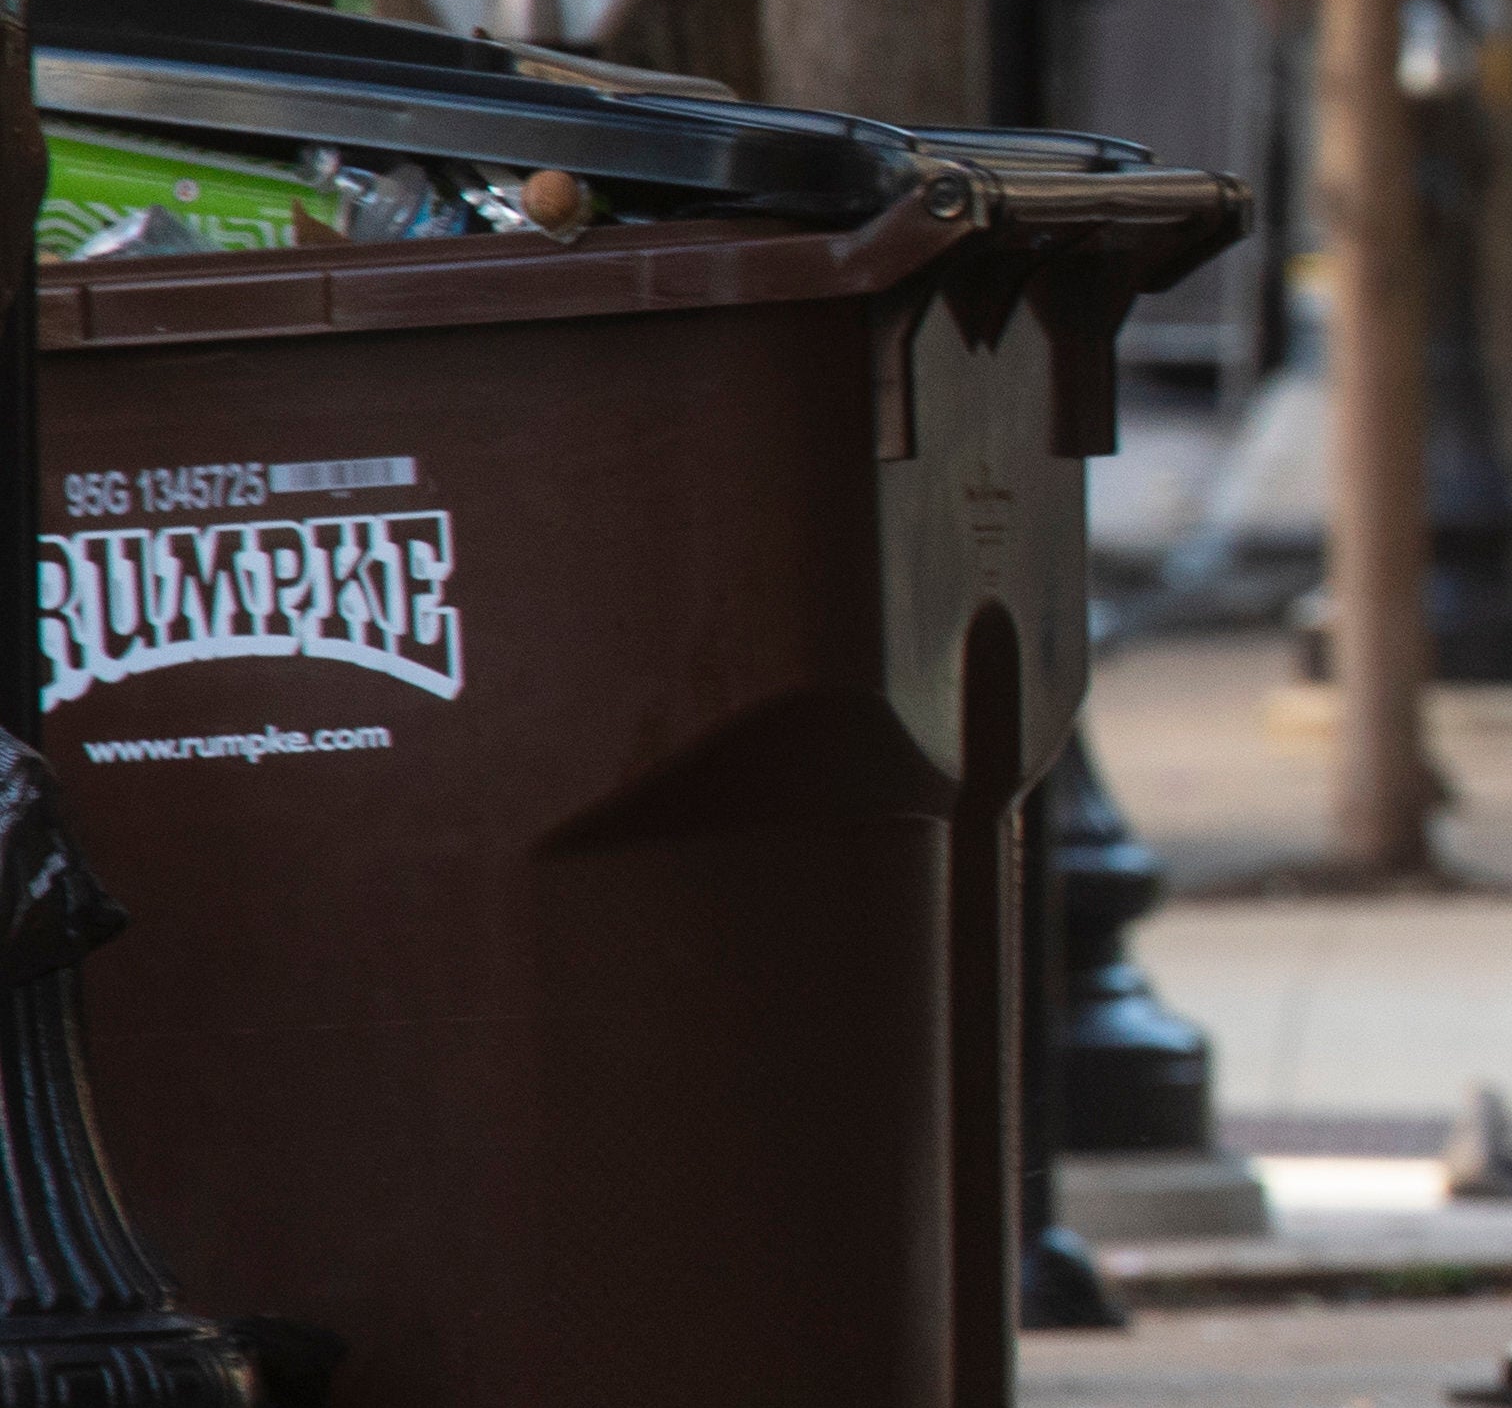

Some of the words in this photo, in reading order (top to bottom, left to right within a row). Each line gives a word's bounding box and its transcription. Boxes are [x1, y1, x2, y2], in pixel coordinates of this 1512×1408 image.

[64, 470, 132, 517] 95G
[136, 462, 267, 512] 1345725
[82, 723, 393, 765] www.rumpke.com
